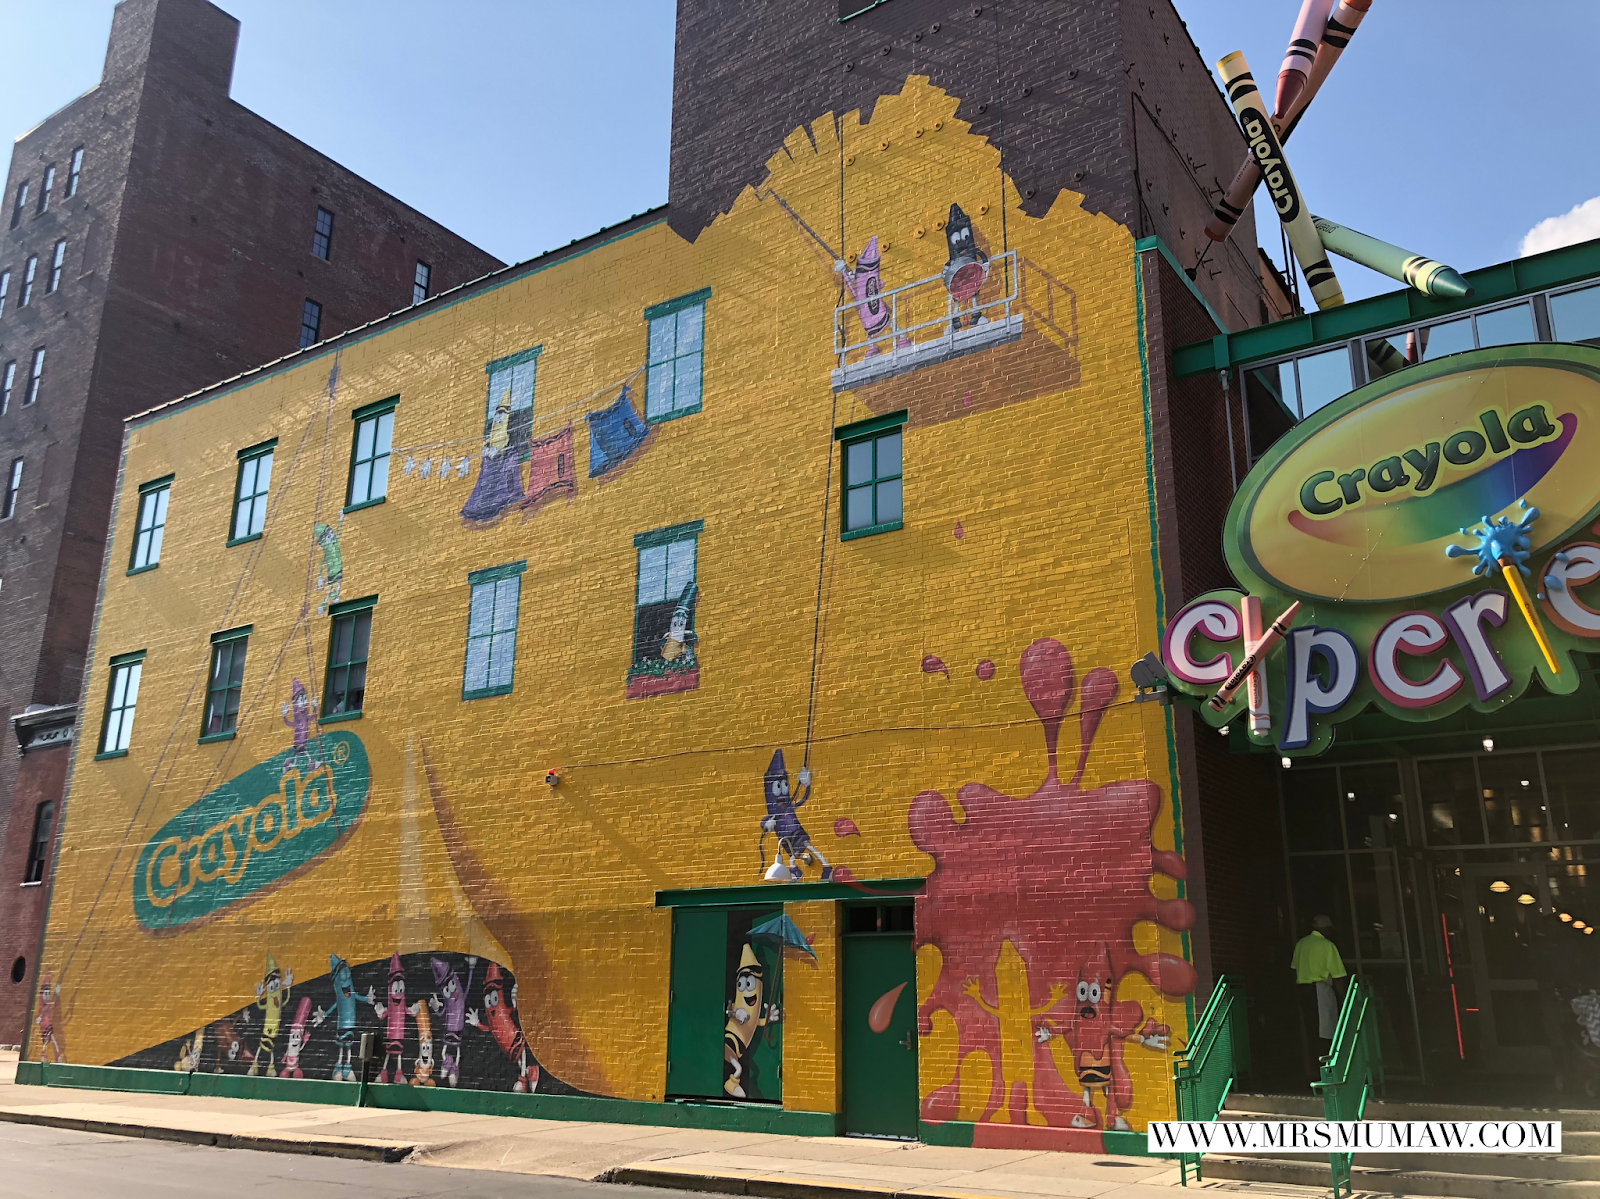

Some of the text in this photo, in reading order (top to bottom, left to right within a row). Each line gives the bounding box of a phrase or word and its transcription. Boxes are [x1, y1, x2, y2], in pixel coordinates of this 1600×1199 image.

[1246, 118, 1293, 214] Crayola
[1299, 403, 1556, 516] Crayola
[1229, 654, 1256, 687] Crayola
